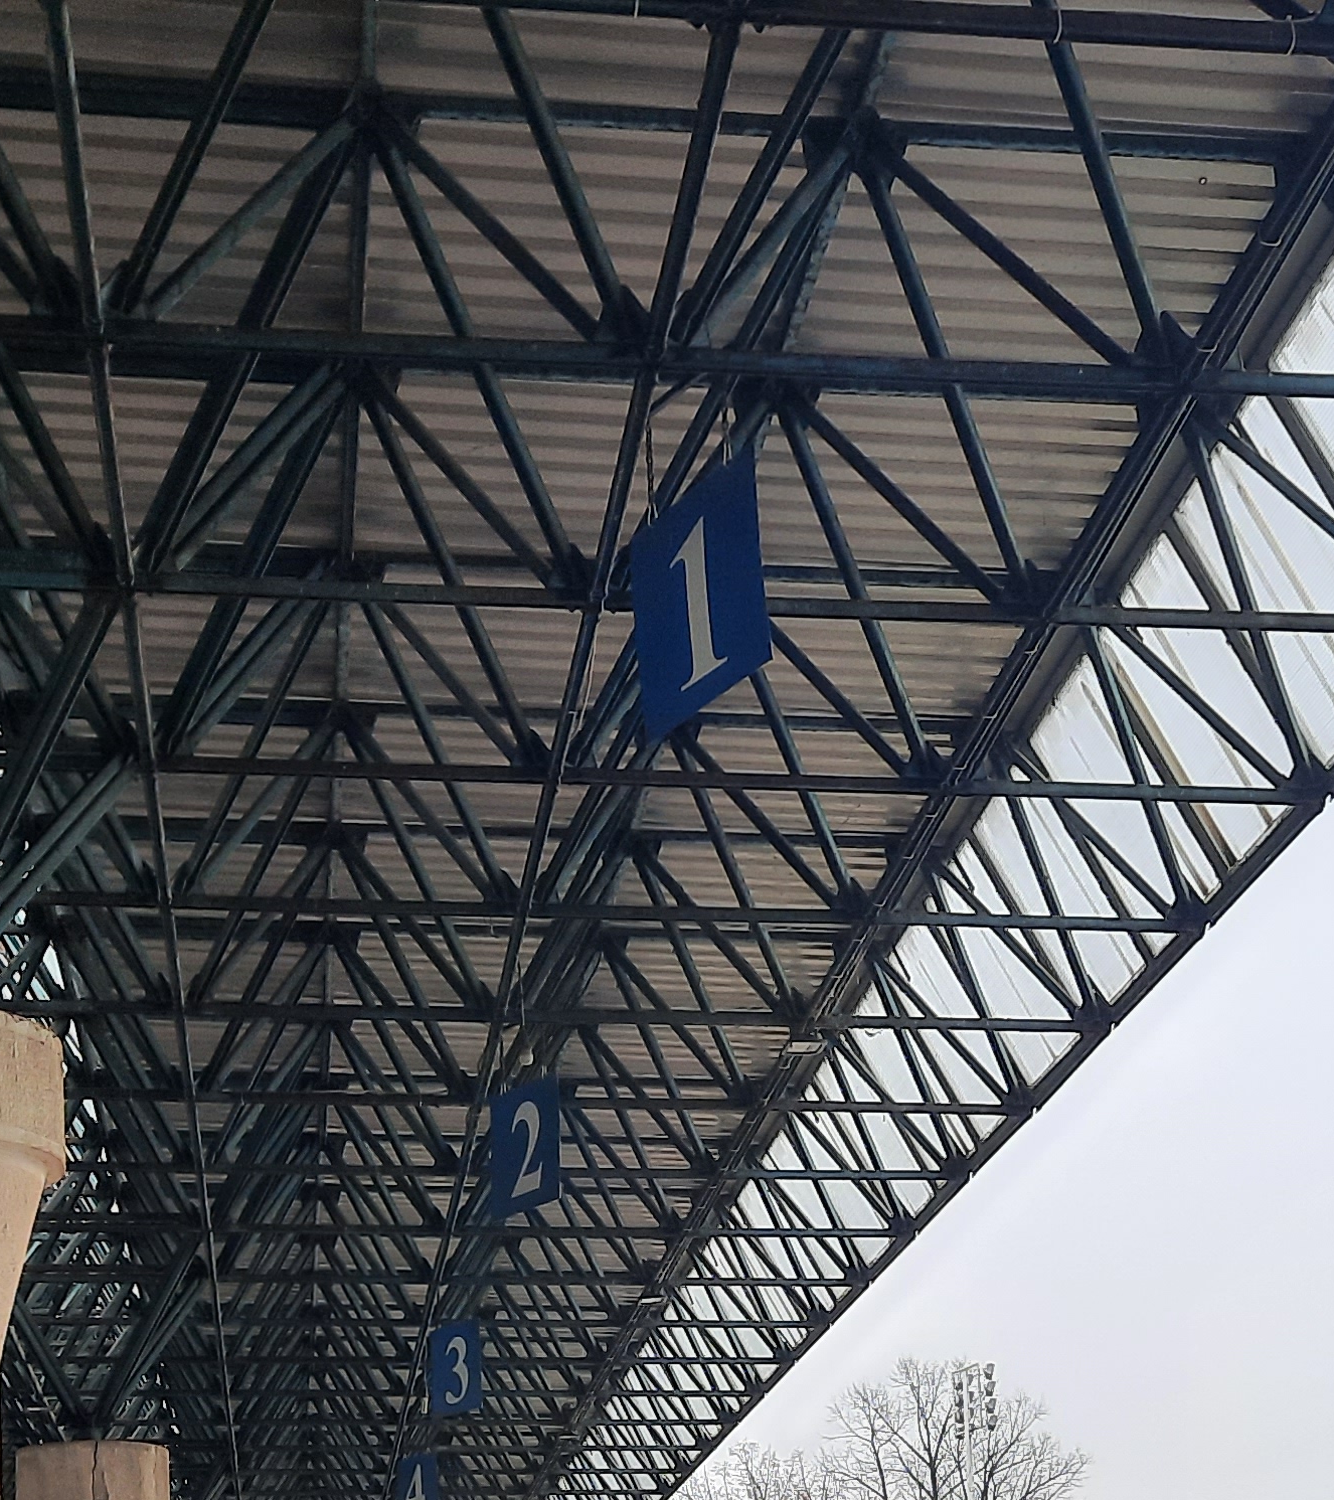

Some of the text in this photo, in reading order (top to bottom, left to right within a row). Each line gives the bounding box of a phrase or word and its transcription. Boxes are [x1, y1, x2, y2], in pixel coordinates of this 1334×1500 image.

[670, 516, 728, 692] 1
[509, 1100, 543, 1199] 2
[444, 1336, 469, 1405] 3
